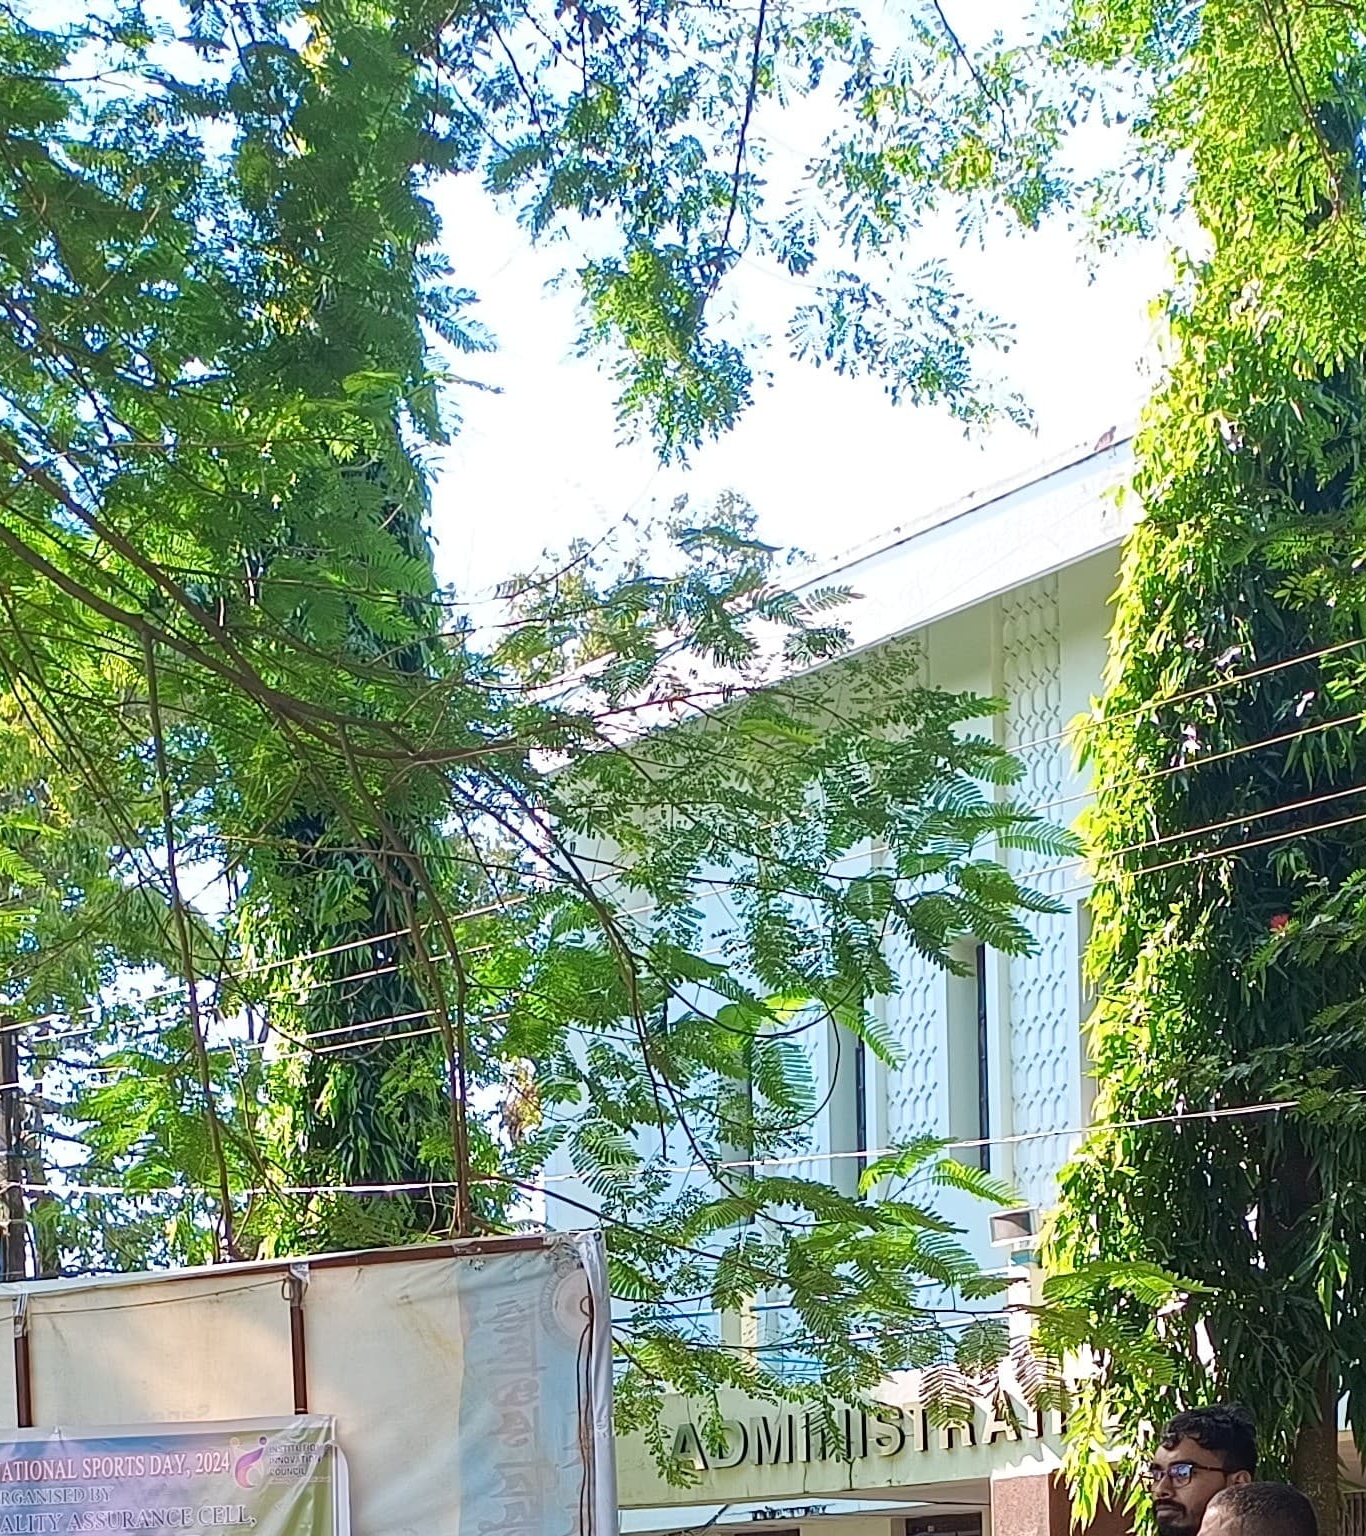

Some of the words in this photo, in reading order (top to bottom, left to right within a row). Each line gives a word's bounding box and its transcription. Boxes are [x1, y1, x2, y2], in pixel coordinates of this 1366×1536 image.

[83, 1455, 145, 1478] SPORTS
[149, 1453, 192, 1477] DAY,
[196, 1451, 231, 1474] 2024
[88, 1486, 114, 1503] BY
[68, 1507, 194, 1532] ASSURANCE
[198, 1504, 257, 1528] CELL,
